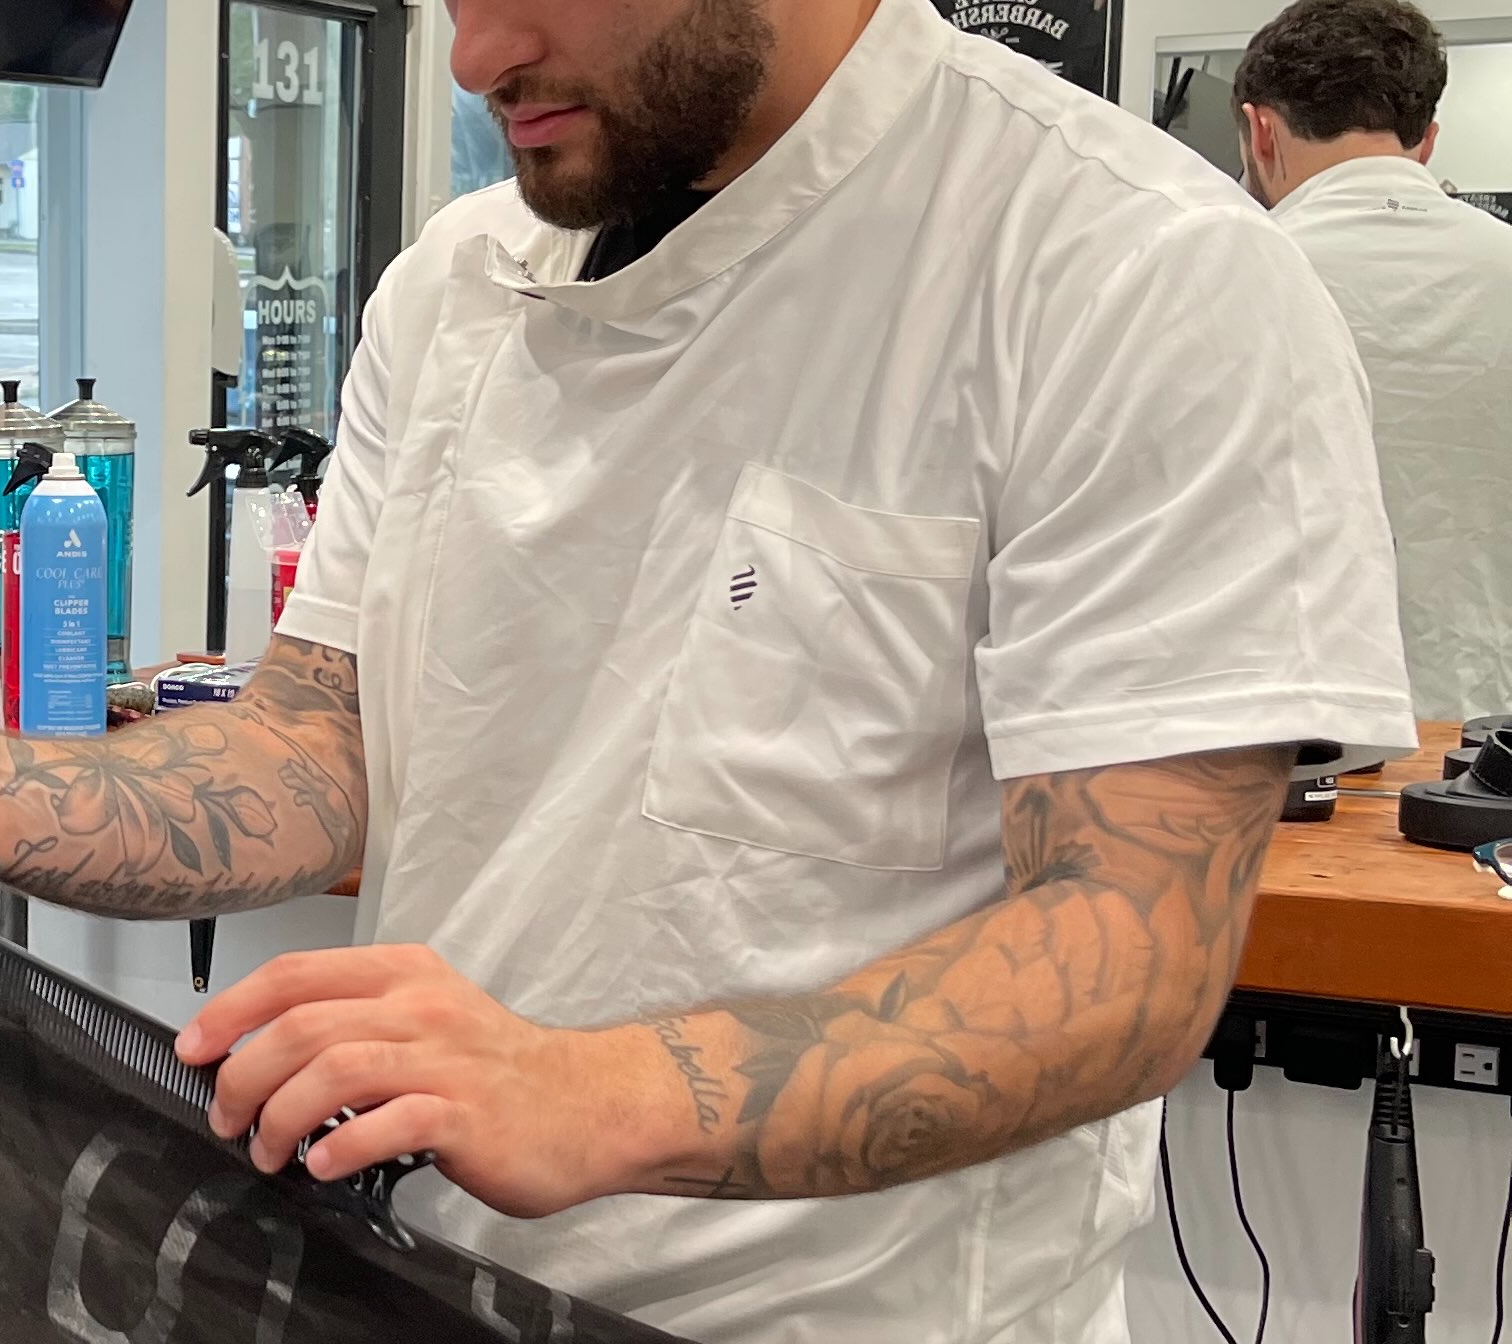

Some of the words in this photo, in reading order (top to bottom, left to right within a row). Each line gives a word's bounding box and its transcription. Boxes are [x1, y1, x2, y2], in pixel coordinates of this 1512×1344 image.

[252, 38, 323, 104] 131
[258, 300, 316, 324] HOURS
[35, 567, 67, 579] COOL
[53, 599, 89, 607] CLIPPER
[54, 607, 88, 615] BLADES
